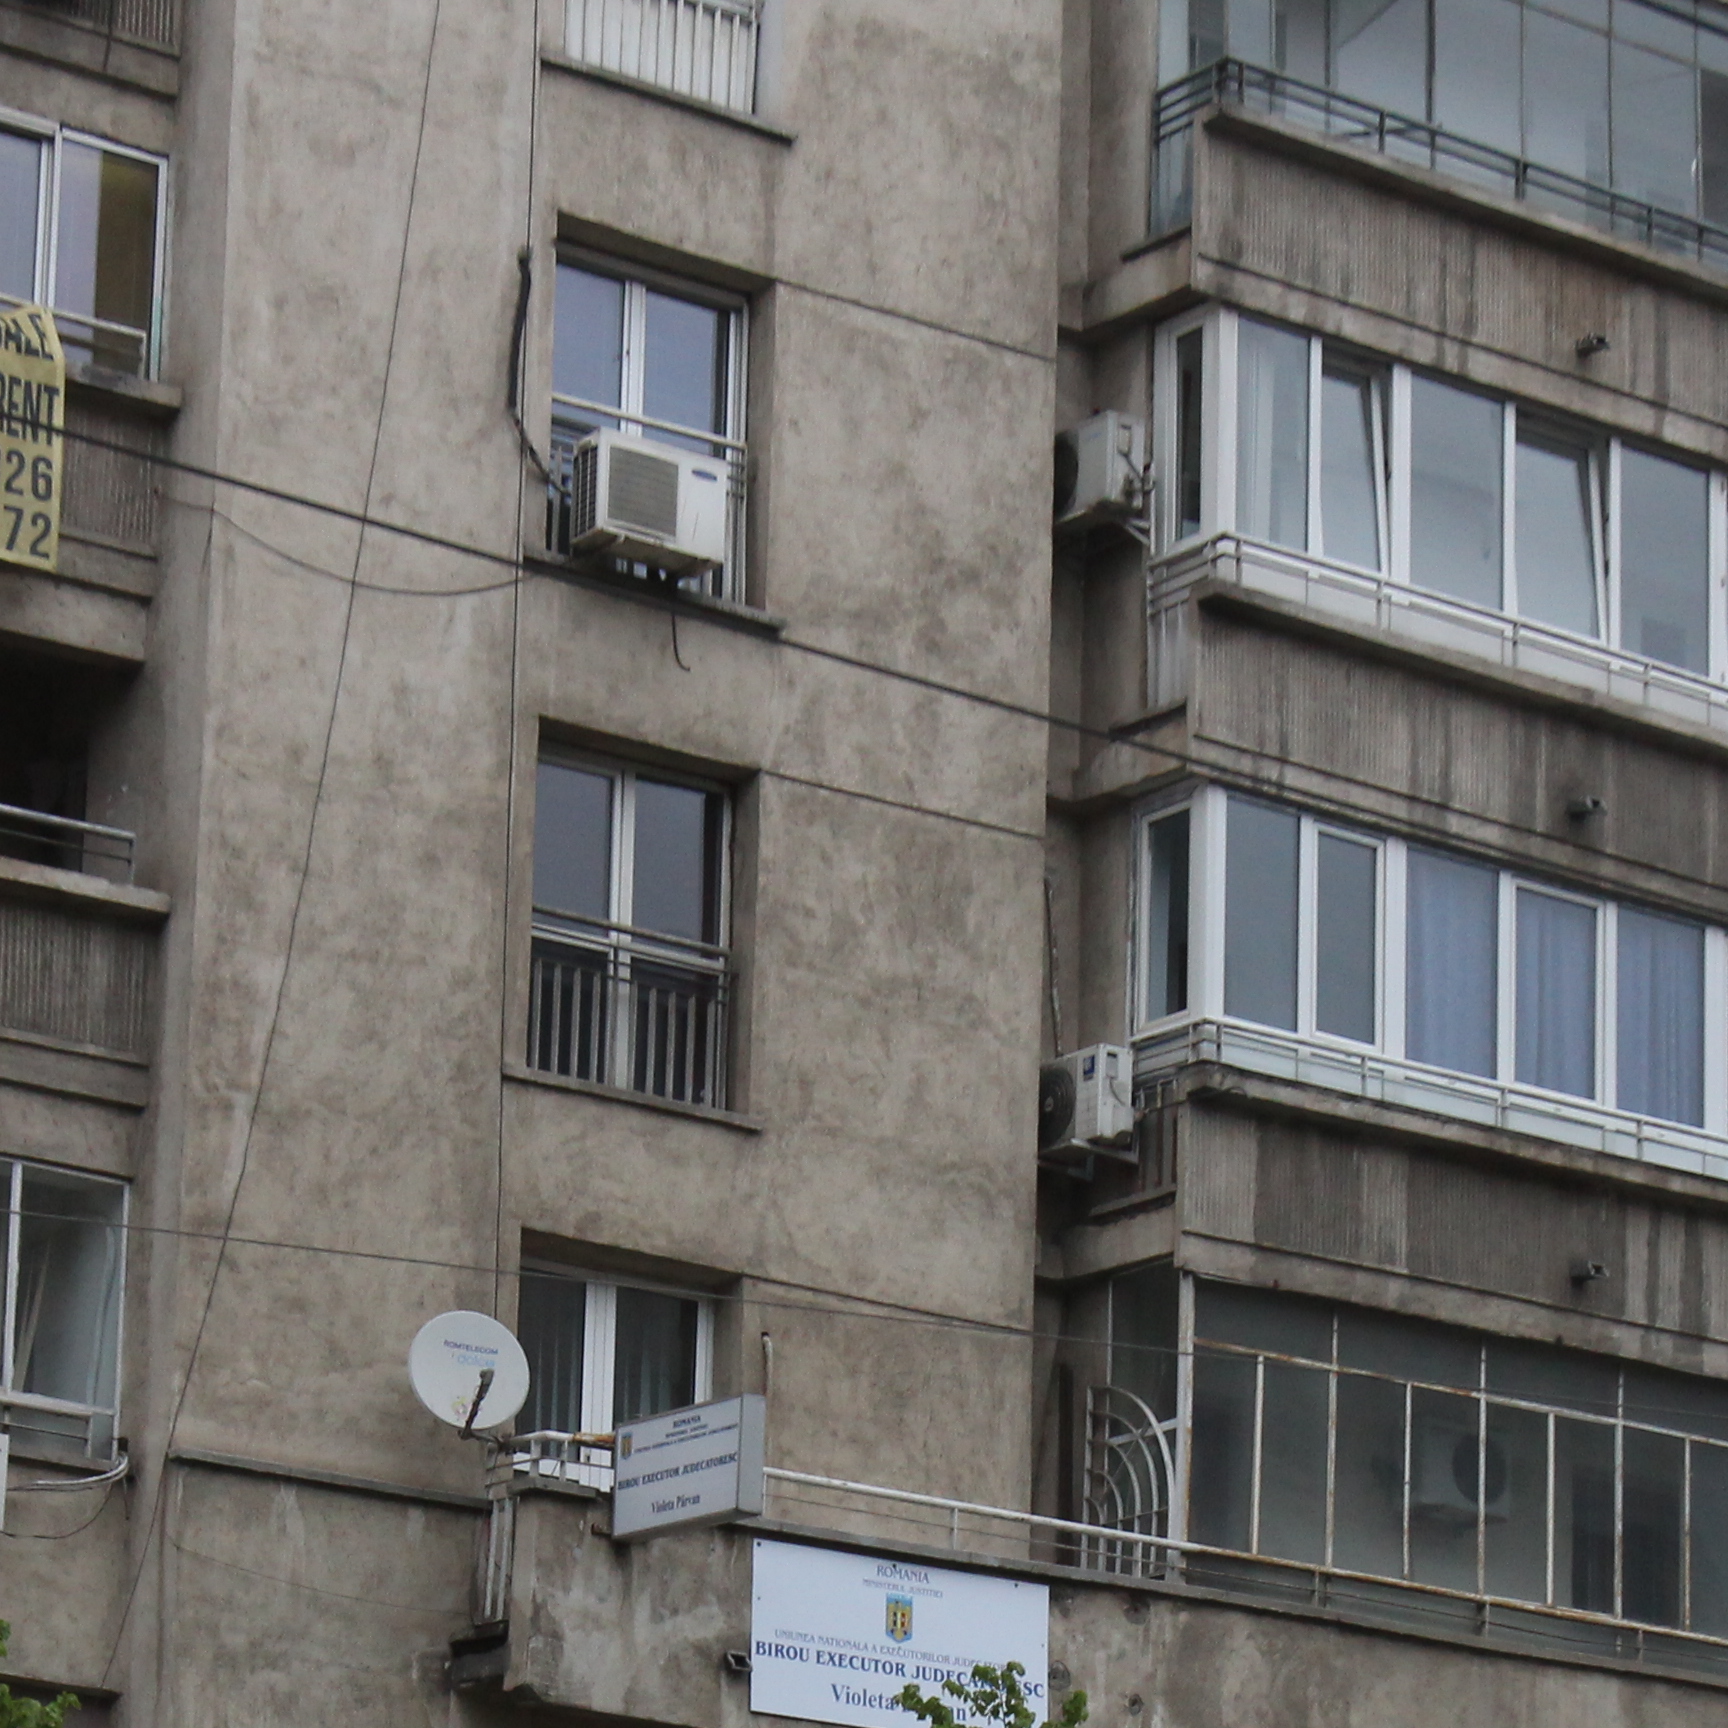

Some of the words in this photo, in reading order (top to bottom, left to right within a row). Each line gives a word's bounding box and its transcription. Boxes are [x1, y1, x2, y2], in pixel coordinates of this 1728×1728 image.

[443, 1339, 499, 1355] ROMTELECOM
[617, 1478, 639, 1490] BIROU
[642, 1466, 680, 1485] EXECUTOR
[651, 1499, 674, 1513] Violeta
[876, 1564, 930, 1584] ROMANIA
[774, 1628, 816, 1643] UNIUNEA
[817, 1634, 870, 1652] NATIONALA
[871, 1643, 879, 1653] A
[755, 1640, 810, 1662] BIROU
[816, 1650, 906, 1677] EXECUTOR
[831, 1683, 895, 1710] Violeta
